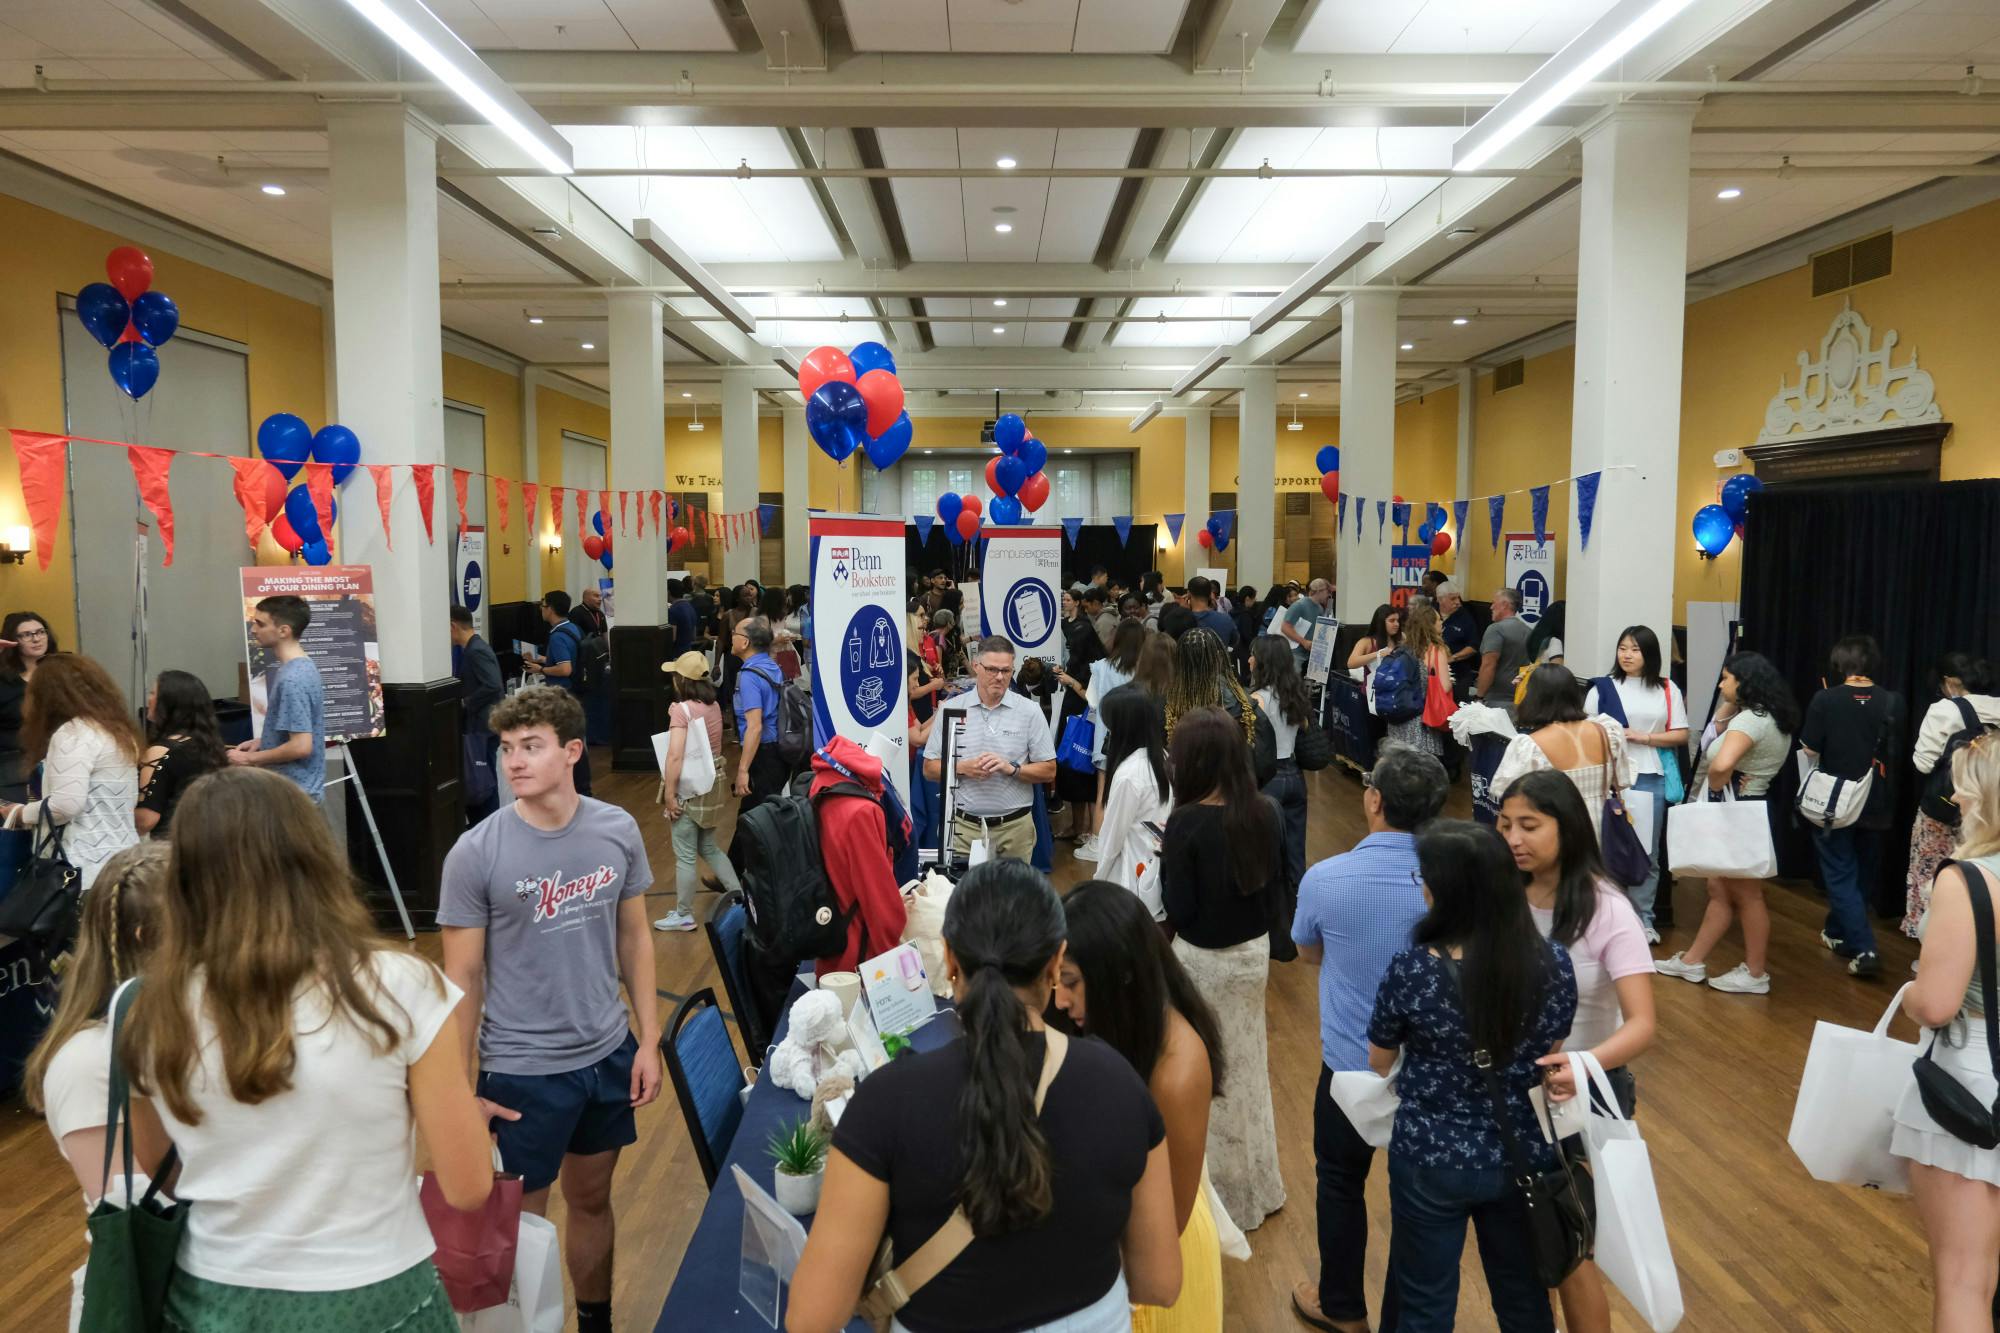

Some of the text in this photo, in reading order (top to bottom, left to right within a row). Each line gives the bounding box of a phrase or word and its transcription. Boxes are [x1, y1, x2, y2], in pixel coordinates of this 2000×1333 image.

[851, 547, 882, 570] Penn
[1525, 544, 1547, 560] Penn
[1411, 558, 1427, 567] THE
[264, 577, 303, 585] MAKING
[851, 570, 897, 588] Bookstore
[272, 584, 300, 592] YOUR
[533, 865, 618, 923] Honey's
